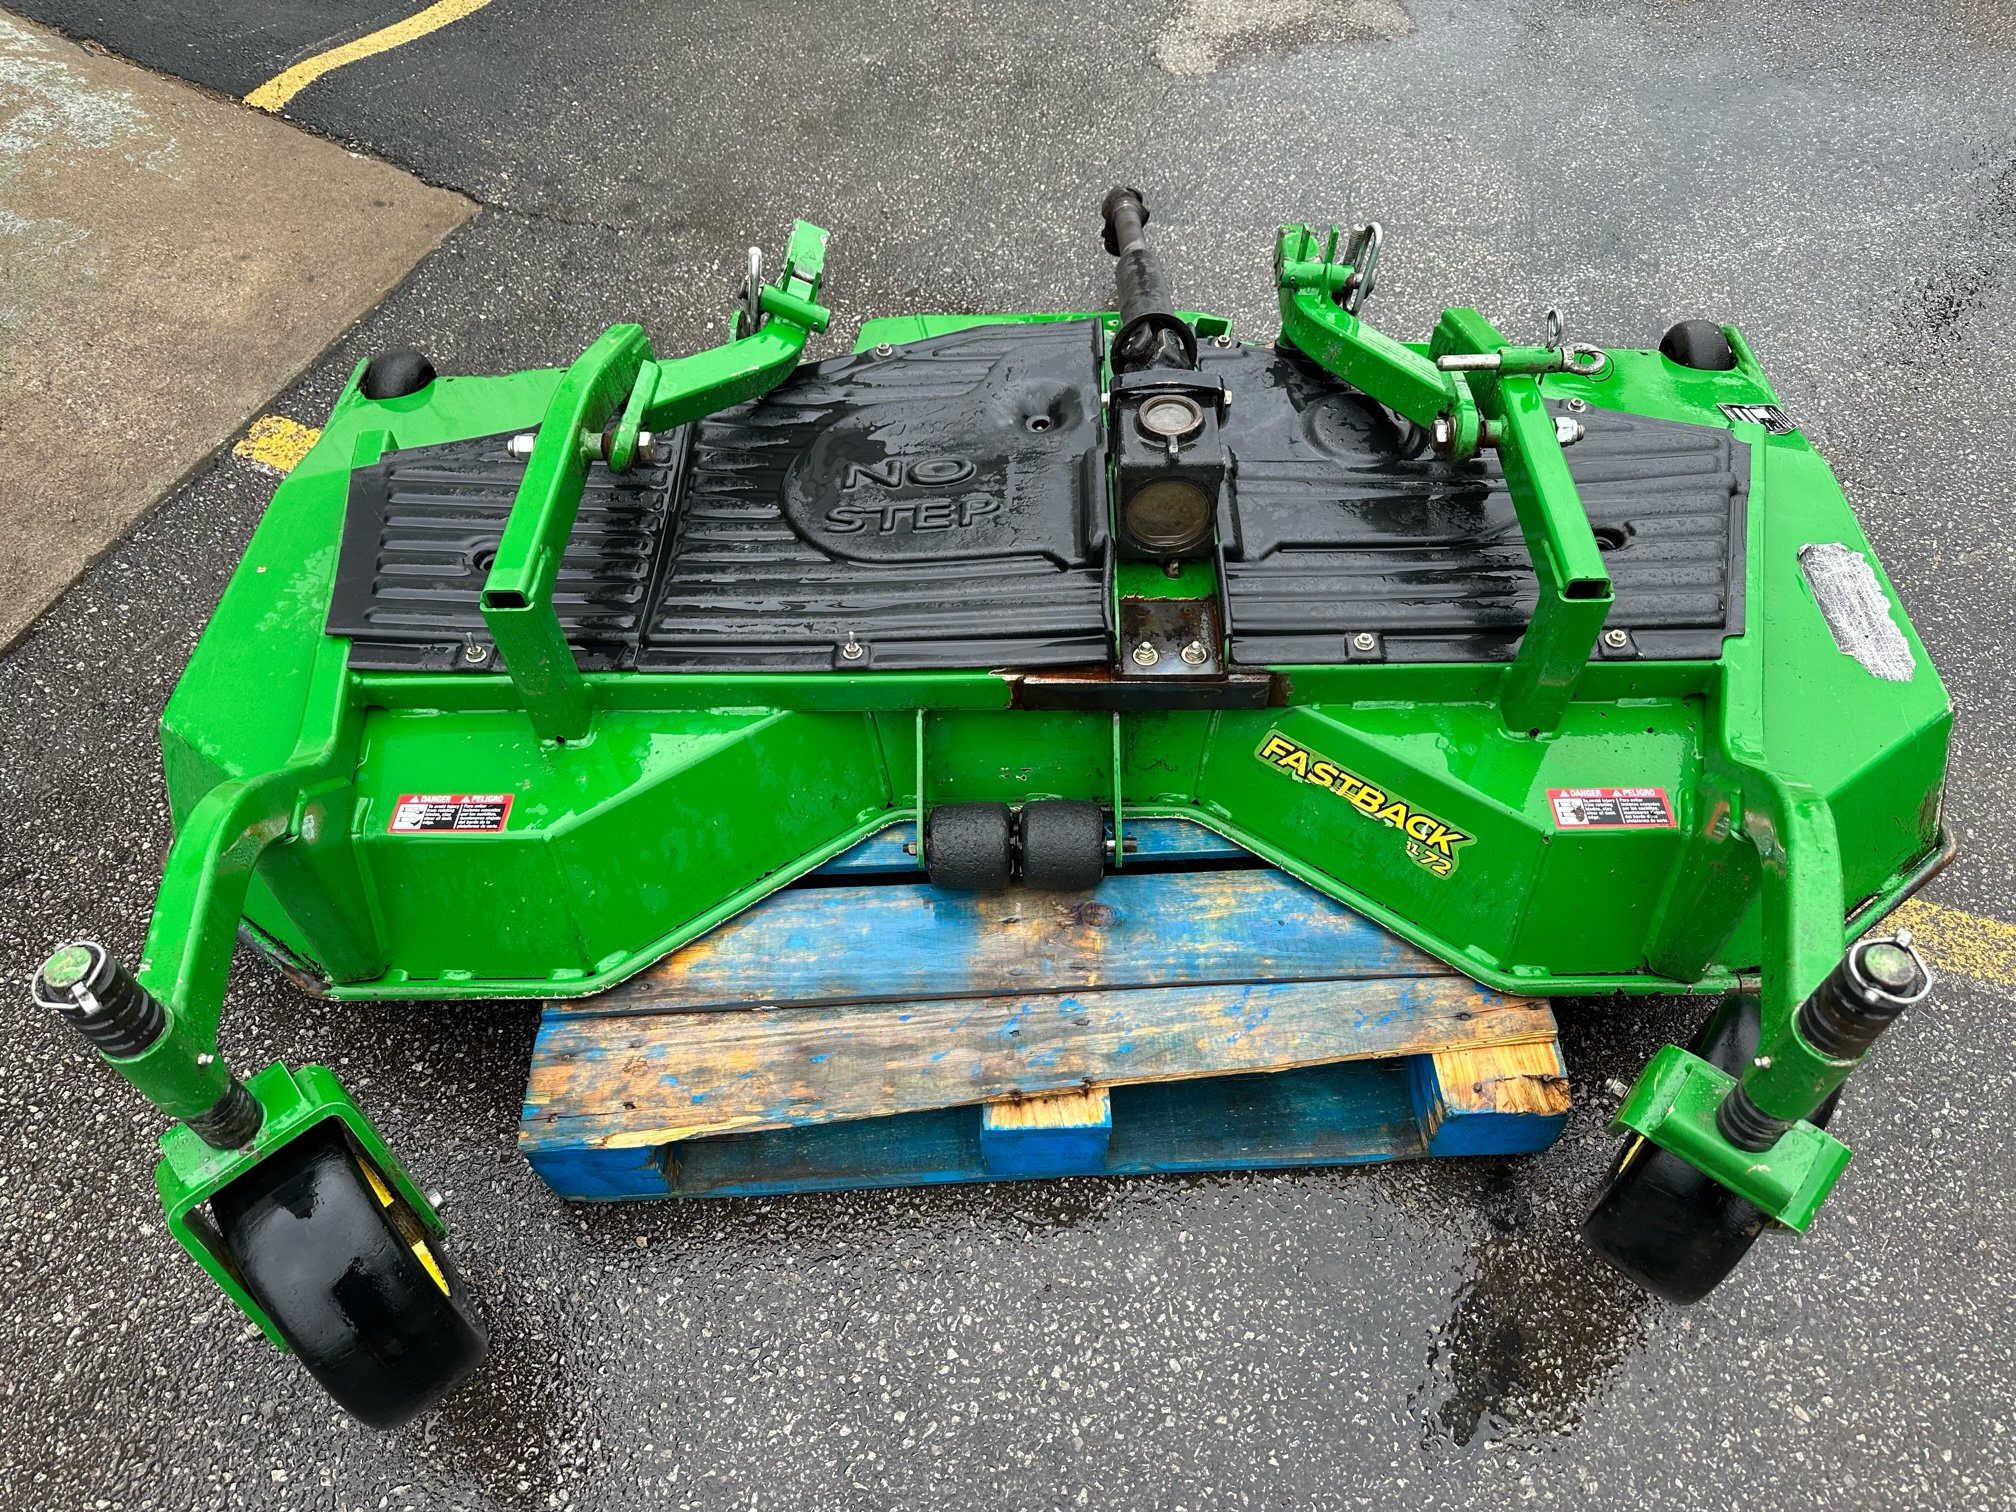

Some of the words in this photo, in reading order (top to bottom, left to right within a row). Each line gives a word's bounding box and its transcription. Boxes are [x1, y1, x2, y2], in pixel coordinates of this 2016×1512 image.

[841, 458, 977, 491] NO
[824, 495, 1001, 534] STEP
[421, 795, 451, 803] DANGER
[471, 795, 503, 803] PELIGRO
[1259, 735, 1471, 860] FASTBACK
[1570, 789, 1601, 797] DANGER
[1622, 789, 1655, 797] PELIGRO
[1416, 849, 1452, 876] 72
